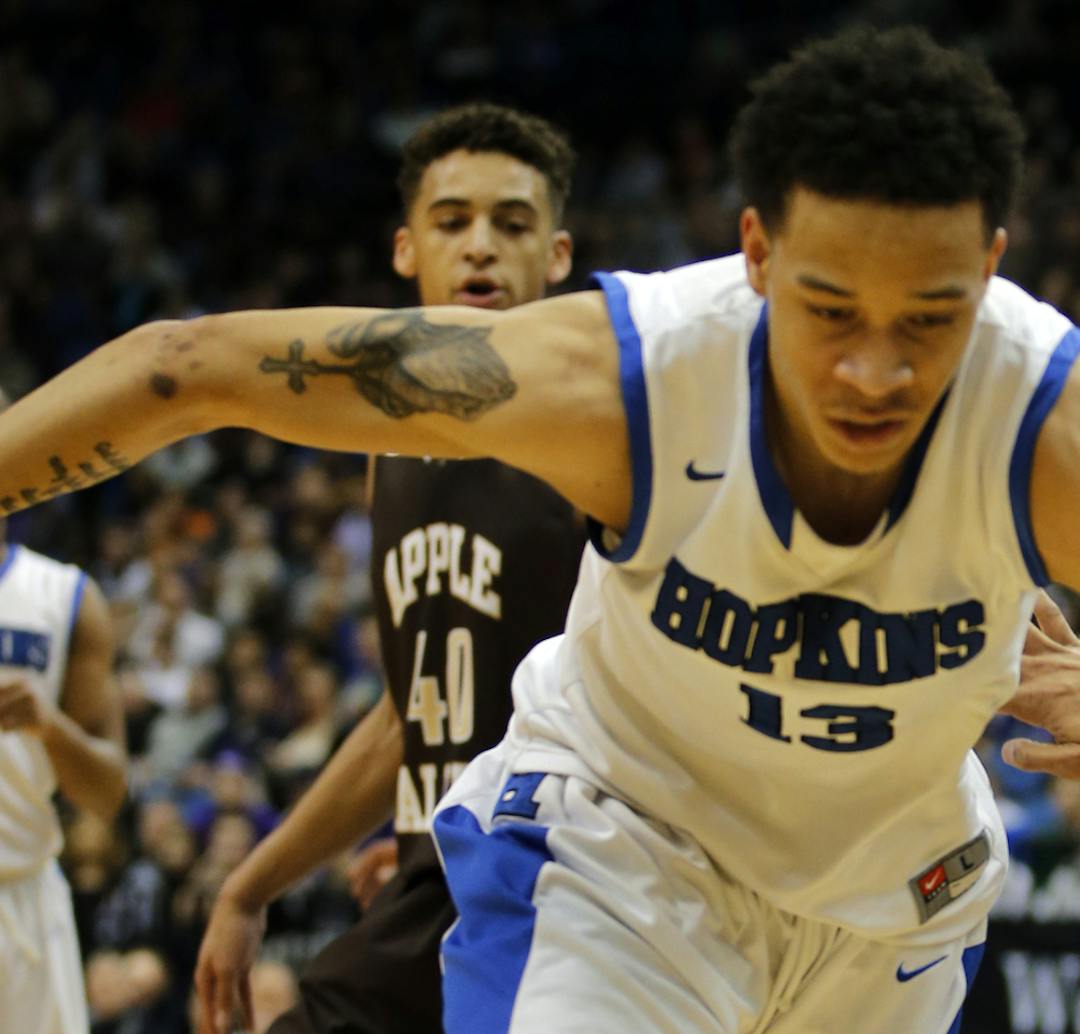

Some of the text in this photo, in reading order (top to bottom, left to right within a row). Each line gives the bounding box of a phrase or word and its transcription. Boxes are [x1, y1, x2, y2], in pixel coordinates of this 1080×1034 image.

[384, 522, 502, 628] APPLE
[651, 556, 986, 687] HOPKINS
[407, 627, 474, 746] 40
[739, 683, 896, 752] 13
